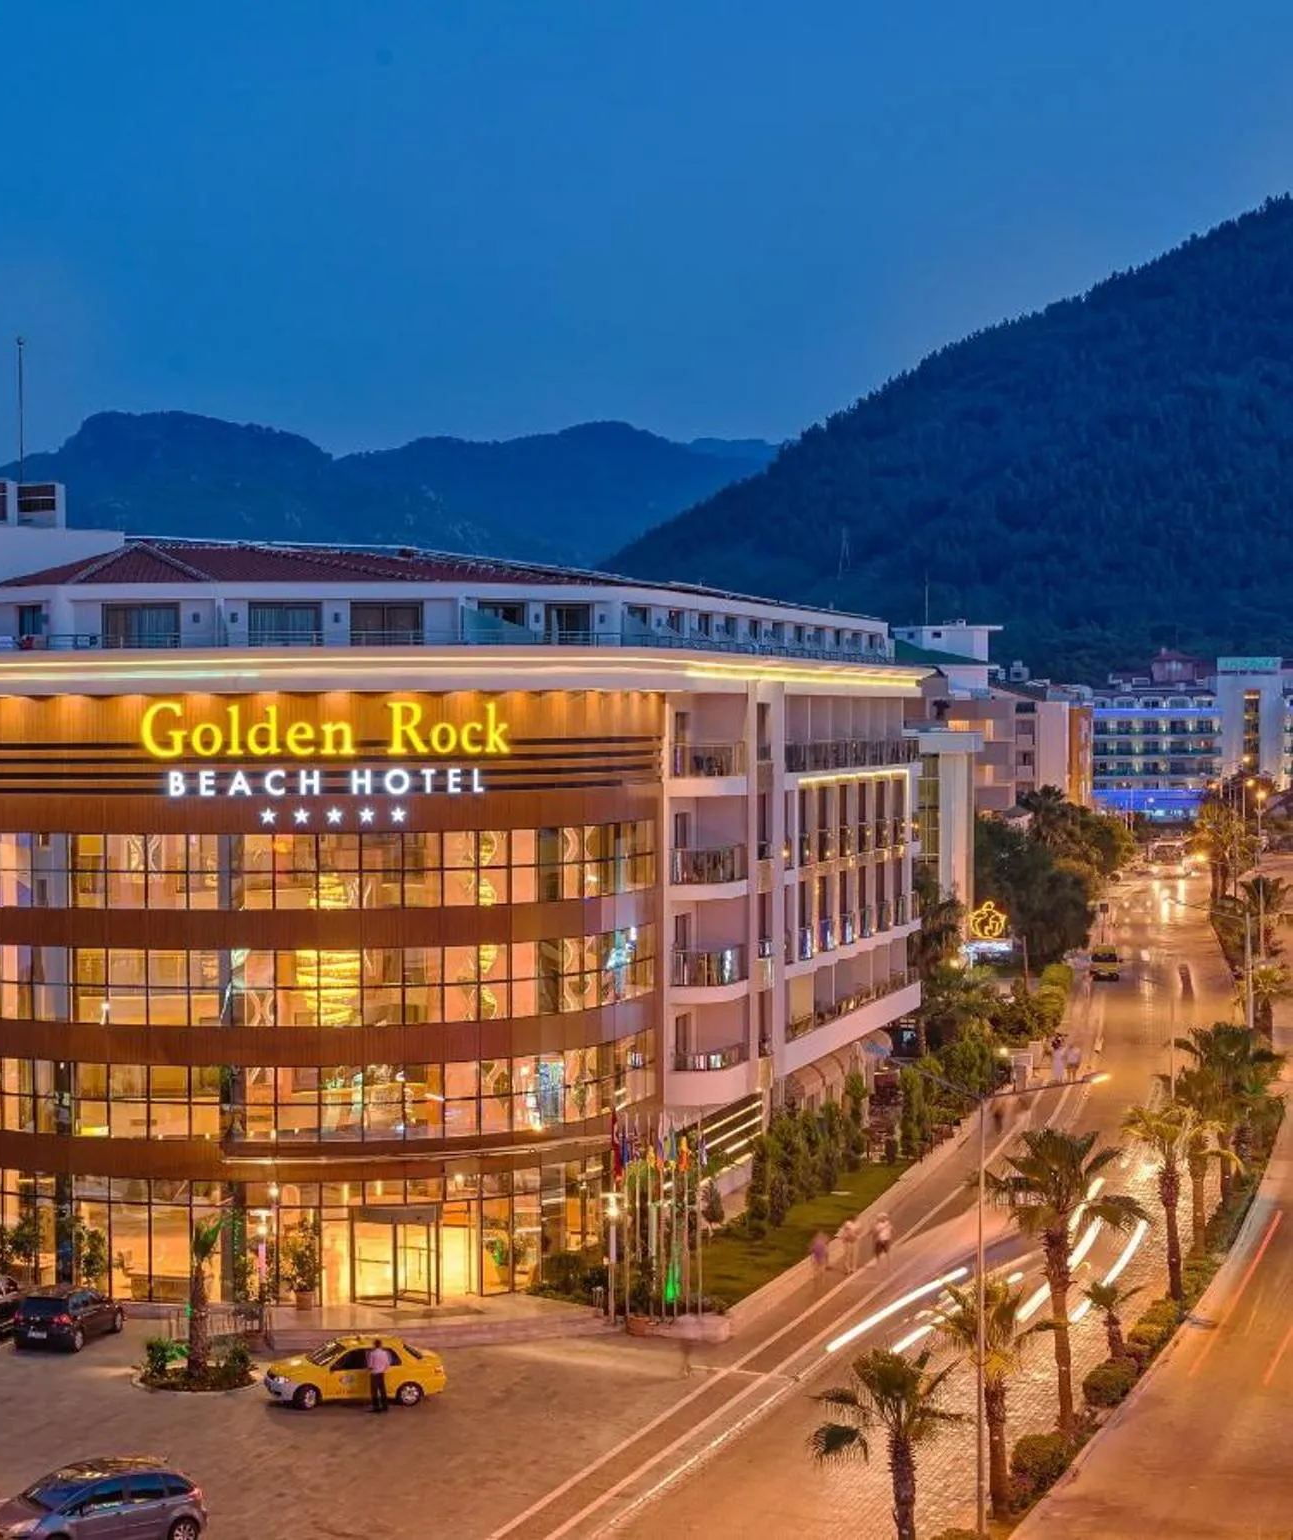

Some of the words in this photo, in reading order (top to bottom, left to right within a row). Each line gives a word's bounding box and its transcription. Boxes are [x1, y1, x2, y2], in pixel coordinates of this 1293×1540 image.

[141, 701, 356, 758] Golden
[387, 701, 510, 754] Rock
[168, 769, 321, 798] BEACH
[351, 767, 485, 796] HOTEL
